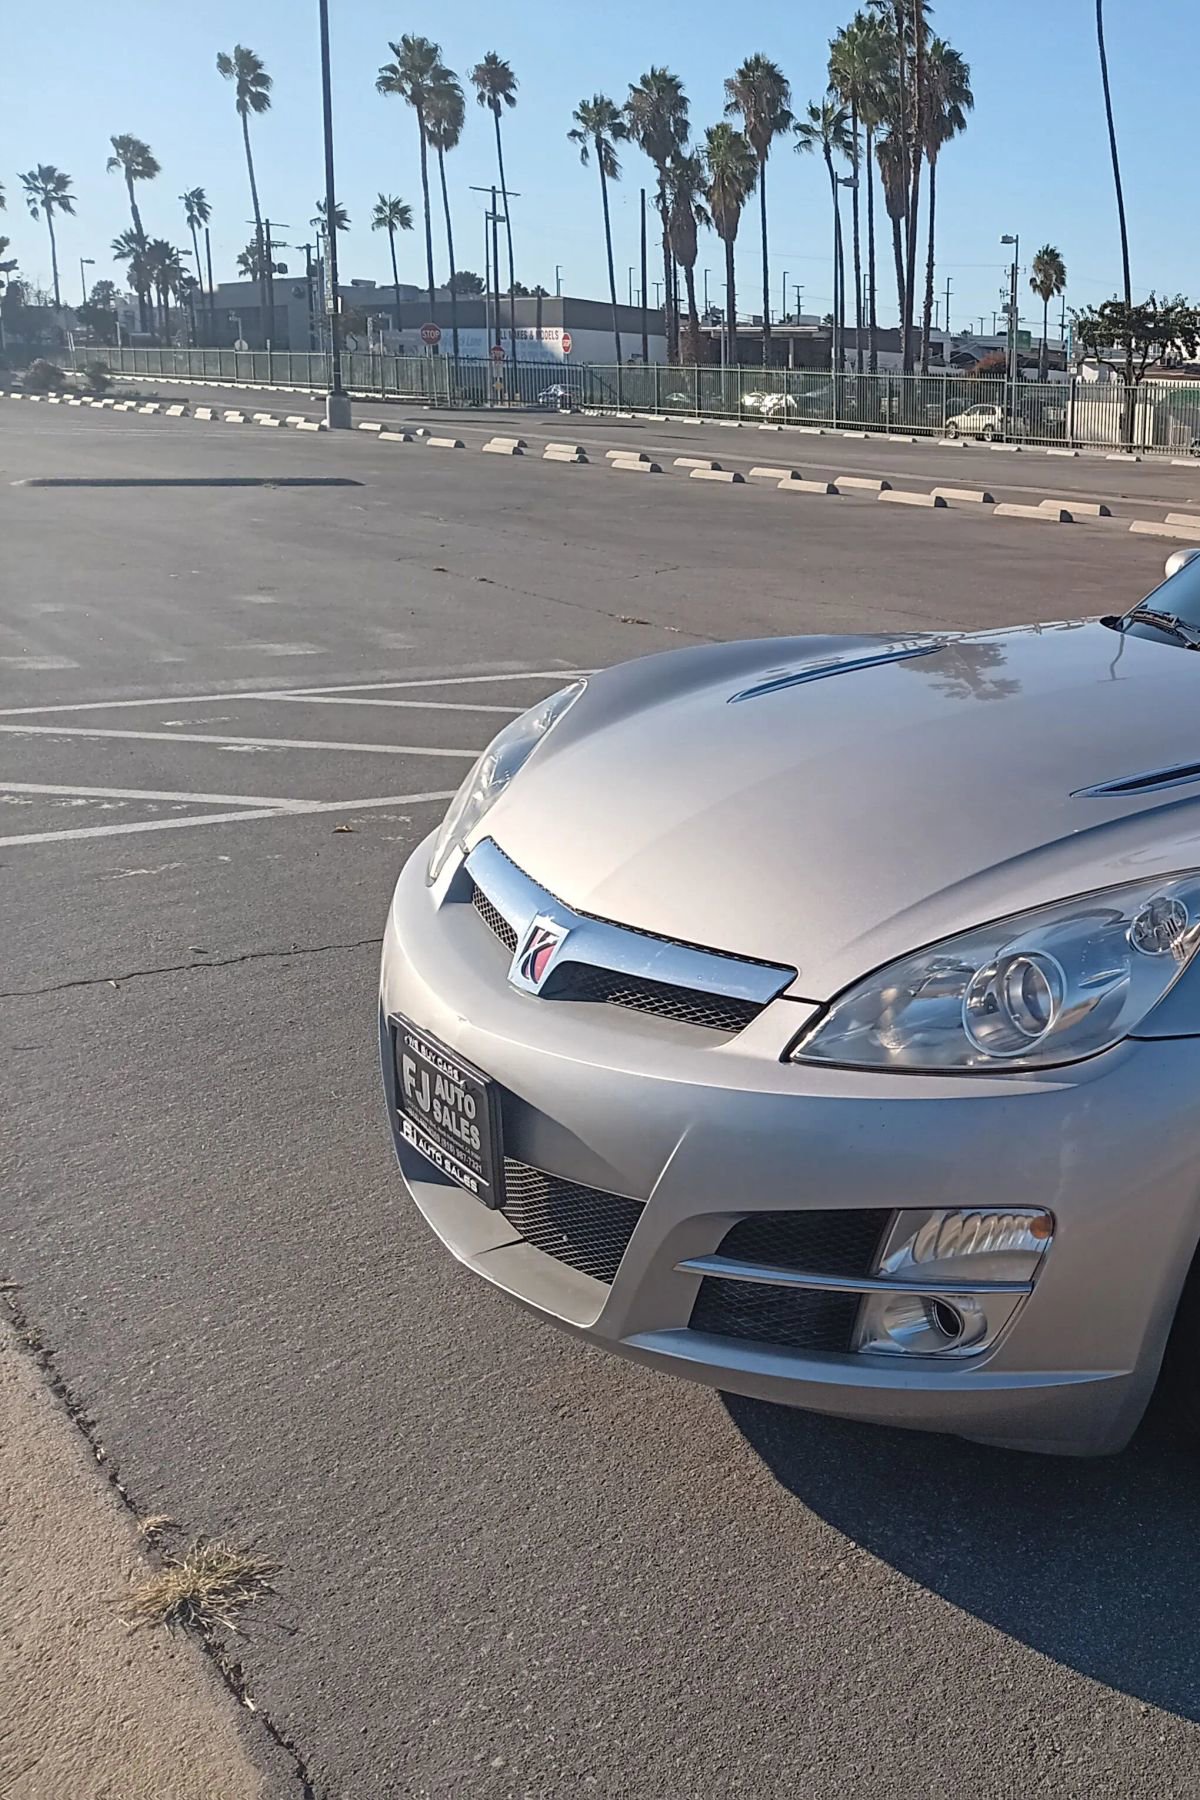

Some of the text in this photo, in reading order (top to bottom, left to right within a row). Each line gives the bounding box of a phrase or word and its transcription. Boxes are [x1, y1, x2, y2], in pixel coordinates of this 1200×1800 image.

[422, 329, 440, 340] STOP
[402, 1053, 431, 1113] FJ
[421, 1045, 436, 1063] BUY
[437, 1058, 459, 1081] CARS
[434, 1074, 476, 1120] AUTO
[432, 1099, 481, 1151] SALES
[419, 1138, 443, 1166] AUTO
[444, 1159, 478, 1193] SALES
